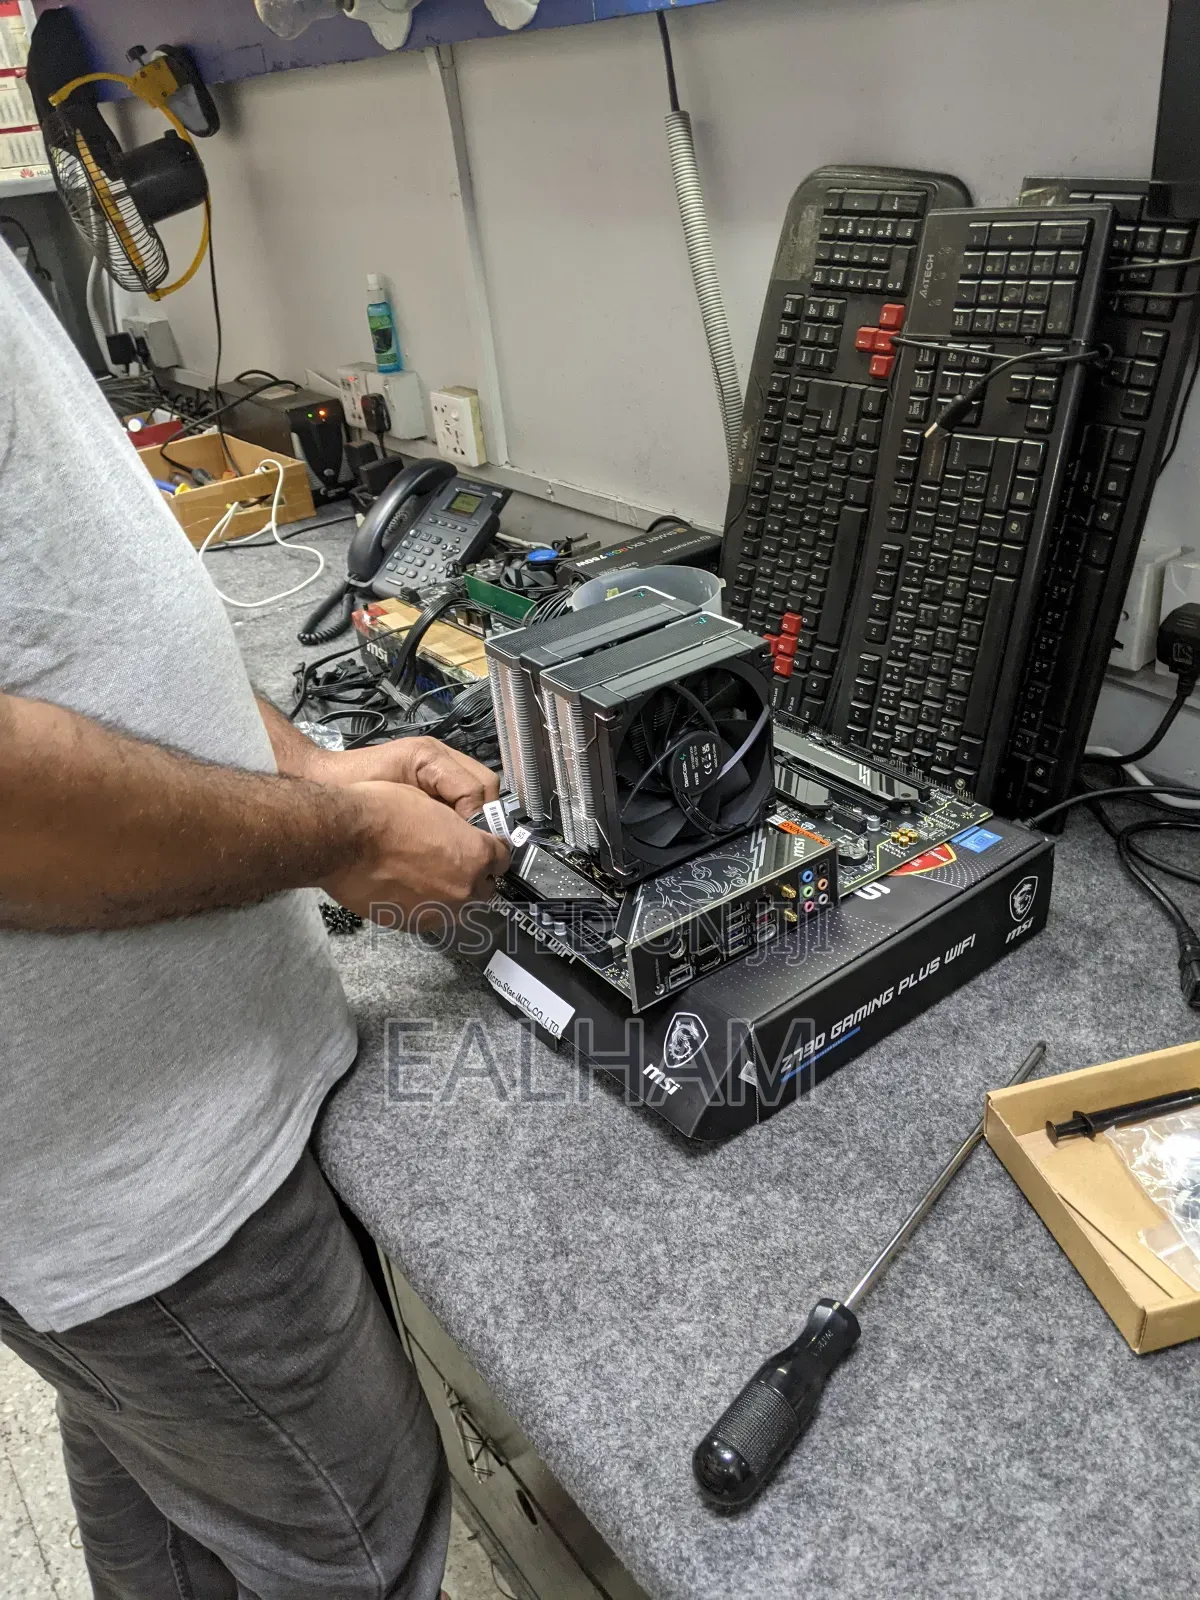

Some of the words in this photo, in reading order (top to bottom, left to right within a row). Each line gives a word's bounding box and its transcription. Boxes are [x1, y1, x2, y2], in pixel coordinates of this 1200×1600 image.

[576, 554, 608, 567] 750W
[366, 640, 388, 663] msi
[794, 838, 806, 858] msi
[1005, 916, 1034, 944] msi
[484, 967, 516, 998] Micro-Star
[780, 1032, 824, 1072] Z790
[830, 988, 894, 1040] GAMING
[898, 958, 940, 995] PLUS
[944, 933, 976, 966] WIFI
[642, 1064, 680, 1096] msi
